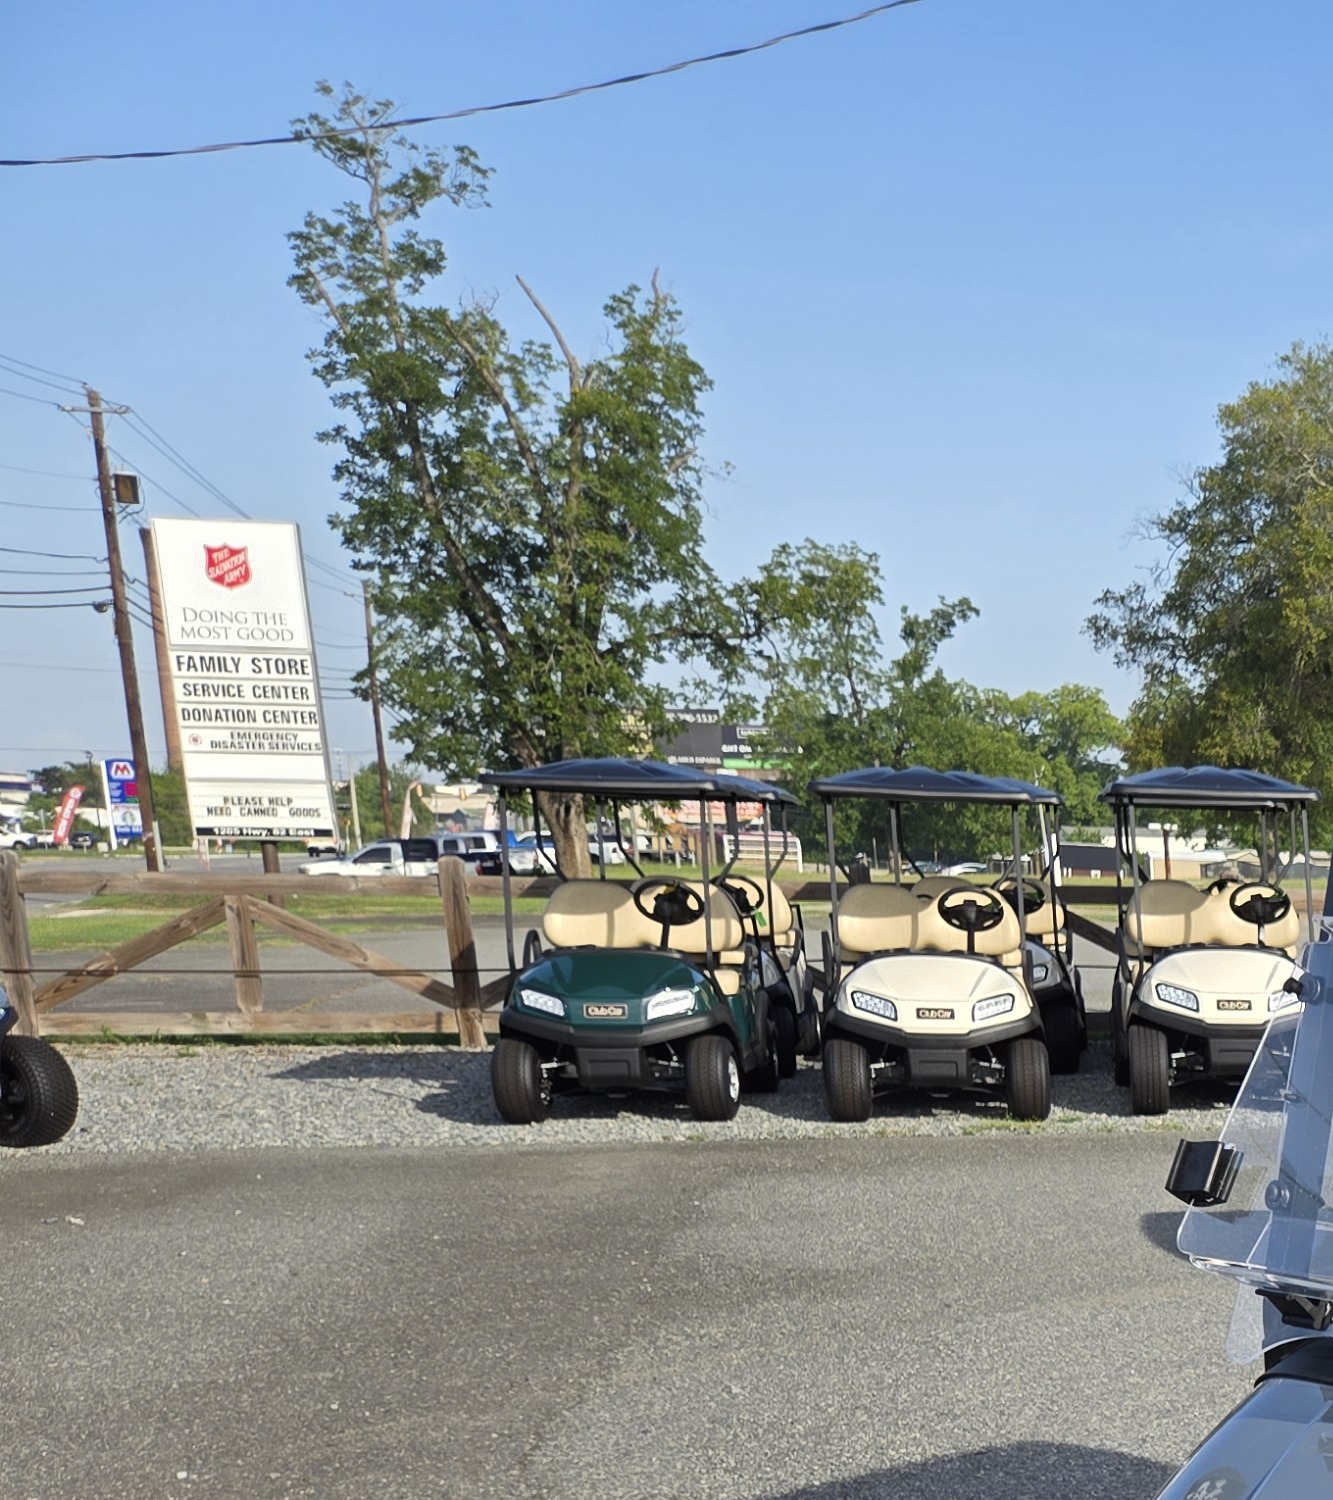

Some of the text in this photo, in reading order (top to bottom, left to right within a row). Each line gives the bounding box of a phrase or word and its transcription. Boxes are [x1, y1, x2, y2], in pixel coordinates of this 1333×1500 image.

[182, 607, 288, 627] DOING THE
[180, 625, 294, 643] MOST GOOD
[175, 654, 311, 676] FAMILY STORE
[182, 682, 310, 701] SERVICE CENTER
[181, 707, 319, 726] DONATION CENTER
[230, 731, 299, 743] EMERGENCY
[210, 740, 323, 753] DISASTER SERVICES
[223, 796, 294, 808] PLEASE HELP
[206, 806, 321, 818] NEED CANNED GOODS
